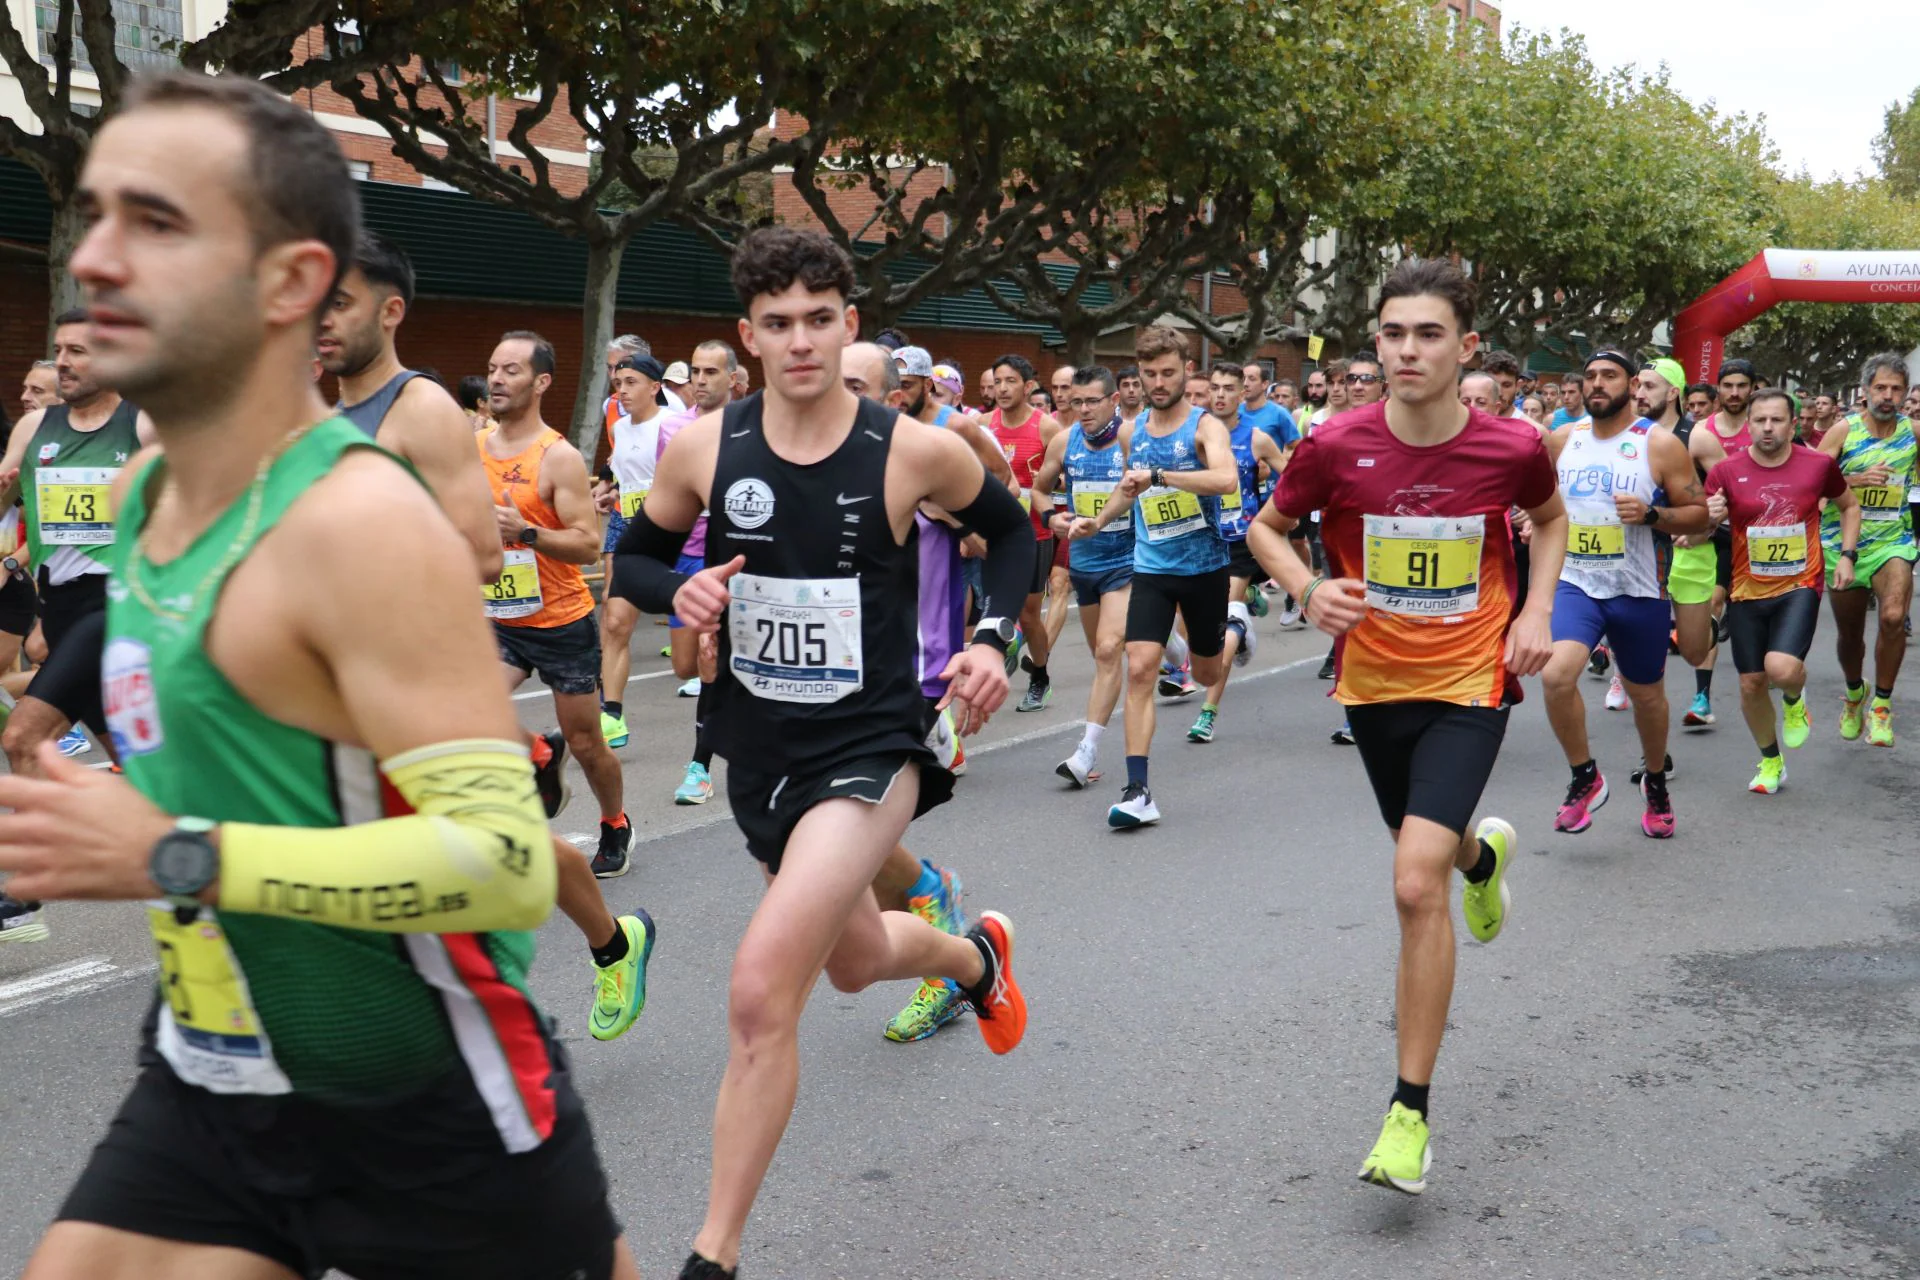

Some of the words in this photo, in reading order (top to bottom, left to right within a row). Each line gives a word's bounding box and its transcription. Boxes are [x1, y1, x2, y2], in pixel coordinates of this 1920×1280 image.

[64, 494, 95, 521] 43
[724, 498, 774, 514] FARTAKH
[1863, 489, 1888, 506] 107
[1157, 499, 1181, 522] 60
[837, 513, 861, 569] NIKE
[1410, 541, 1439, 550] CESAR
[1578, 532, 1602, 553] 54
[1767, 543, 1789, 562] 22
[1408, 552, 1439, 587] 91
[493, 575, 516, 599] 83
[1406, 598, 1460, 609] HYUNDAI
[756, 619, 827, 666] 205
[775, 682, 838, 694] HYUNDAI
